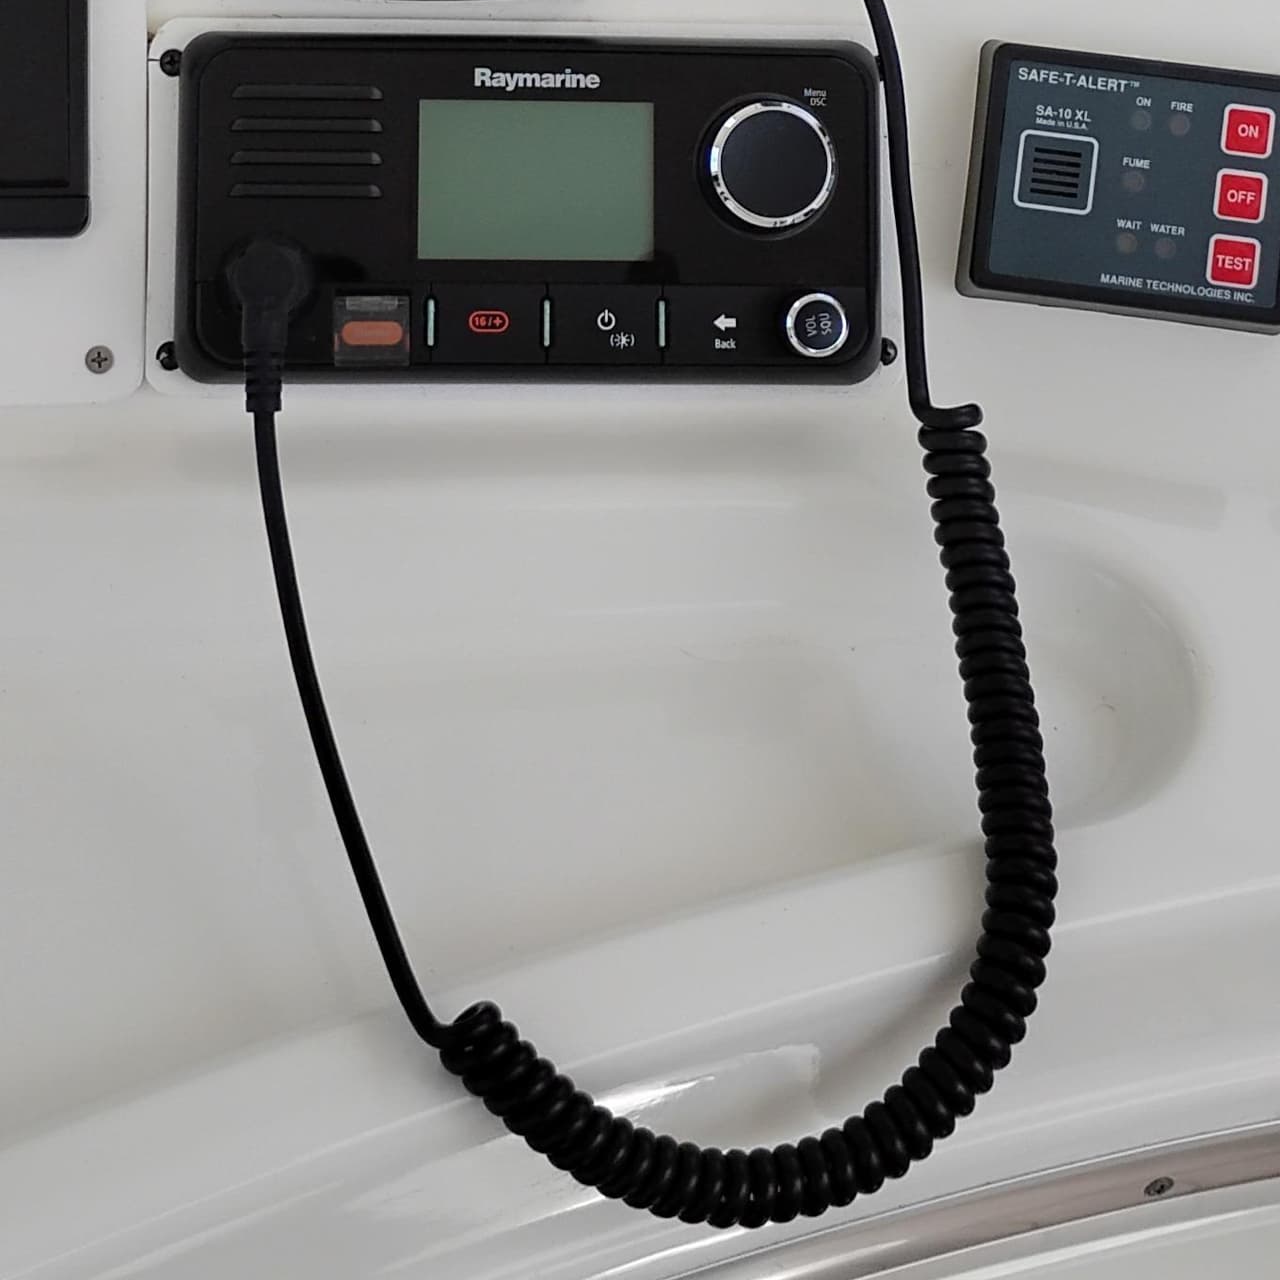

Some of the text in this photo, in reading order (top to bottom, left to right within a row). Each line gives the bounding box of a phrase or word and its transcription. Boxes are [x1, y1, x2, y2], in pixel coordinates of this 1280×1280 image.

[473, 68, 601, 91] Raymarine
[803, 87, 828, 98] Menu
[810, 97, 828, 107] DSC
[1136, 96, 1153, 107] ON
[1170, 101, 1194, 113] FIRE
[1036, 104, 1092, 122] SA-10 XL
[1035, 116, 1056, 126] Made
[1057, 119, 1065, 127] in
[1237, 123, 1260, 138] ON
[1122, 156, 1152, 170] FUME
[1227, 189, 1256, 205] OFF
[1116, 218, 1142, 231] WAIT
[1150, 222, 1185, 237] WATER
[1216, 254, 1253, 271] TEST
[1100, 273, 1256, 304] MARINE TECHNOLOGIES INC.
[806, 314, 817, 337] VOL
[714, 338, 737, 350] Back
